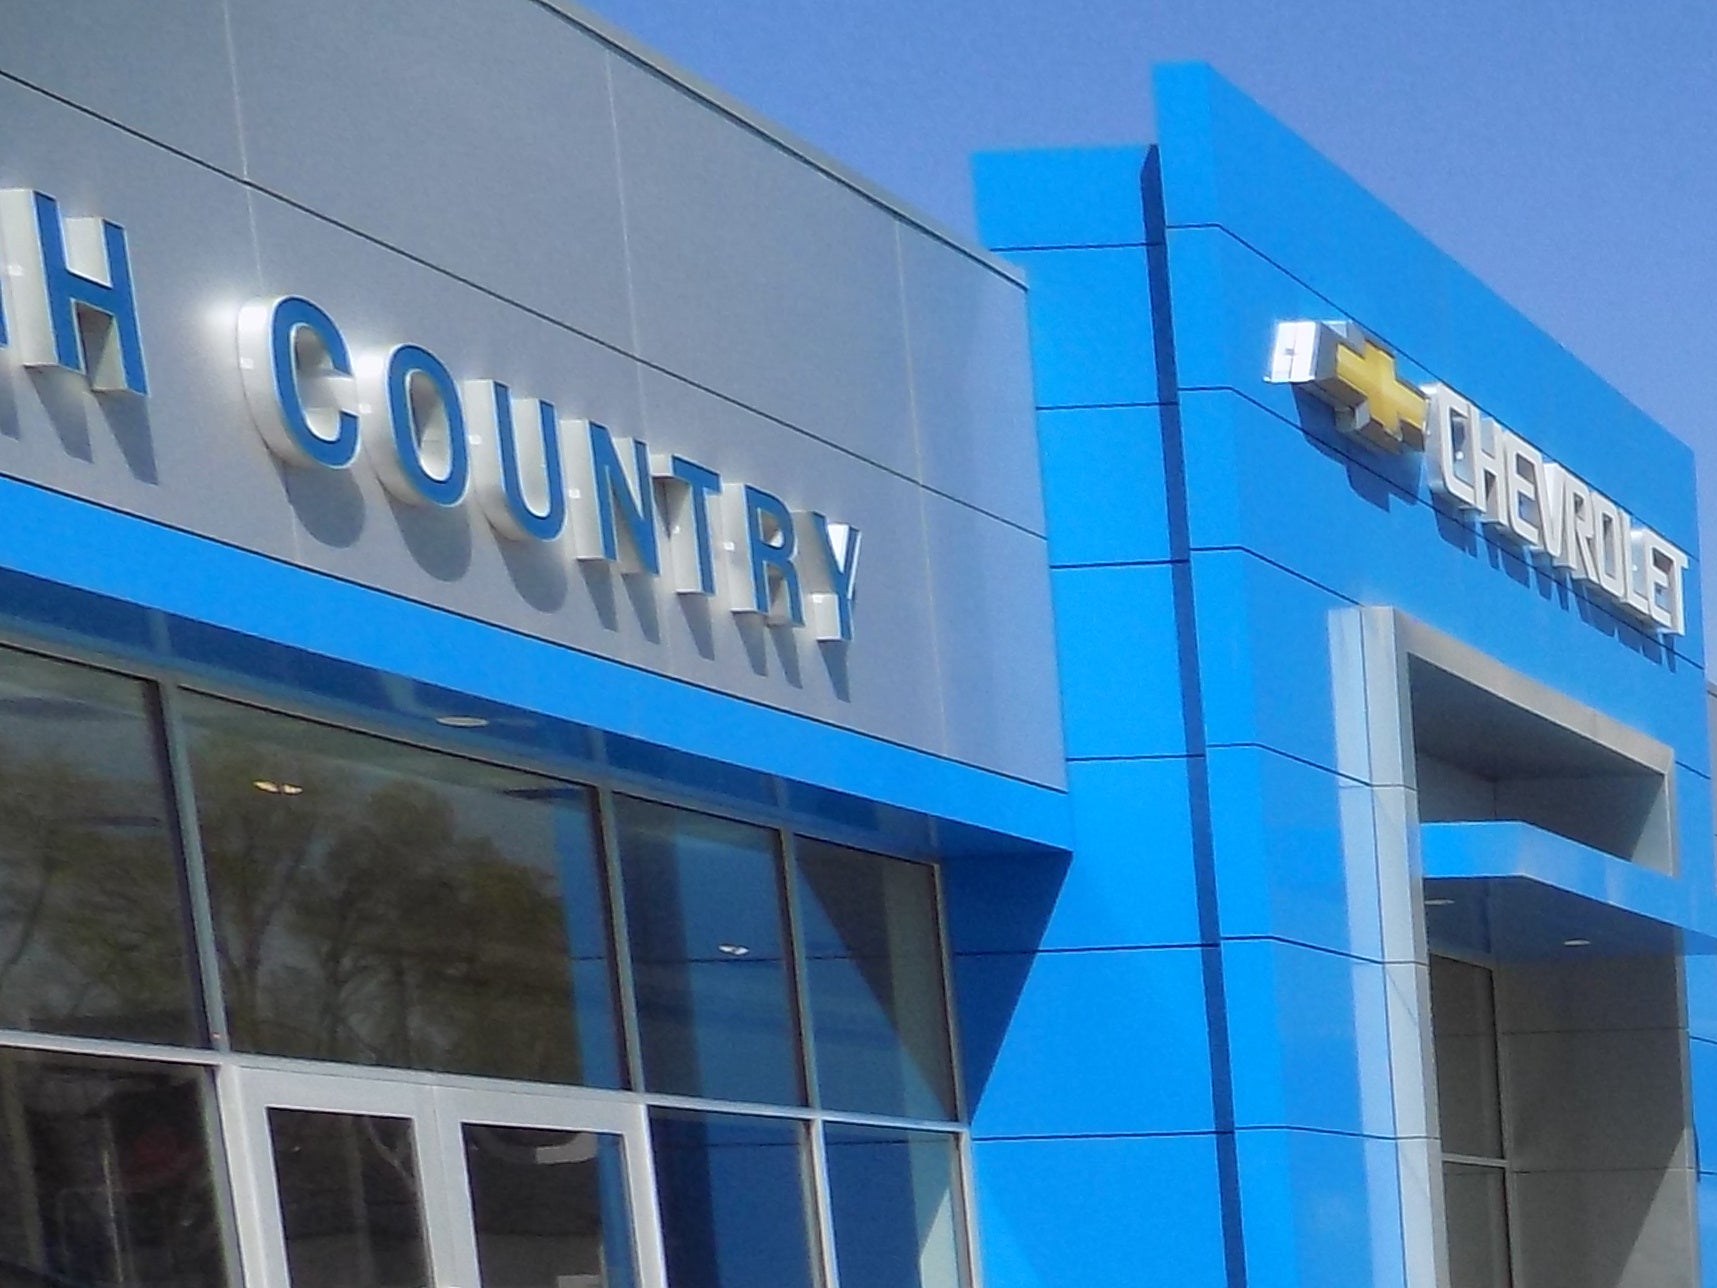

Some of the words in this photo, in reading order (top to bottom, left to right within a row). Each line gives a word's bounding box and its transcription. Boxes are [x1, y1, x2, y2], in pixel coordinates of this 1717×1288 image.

[0, 190, 151, 398] H
[246, 295, 863, 642] COUNTRY
[1422, 381, 1689, 637] CHEVROLET
